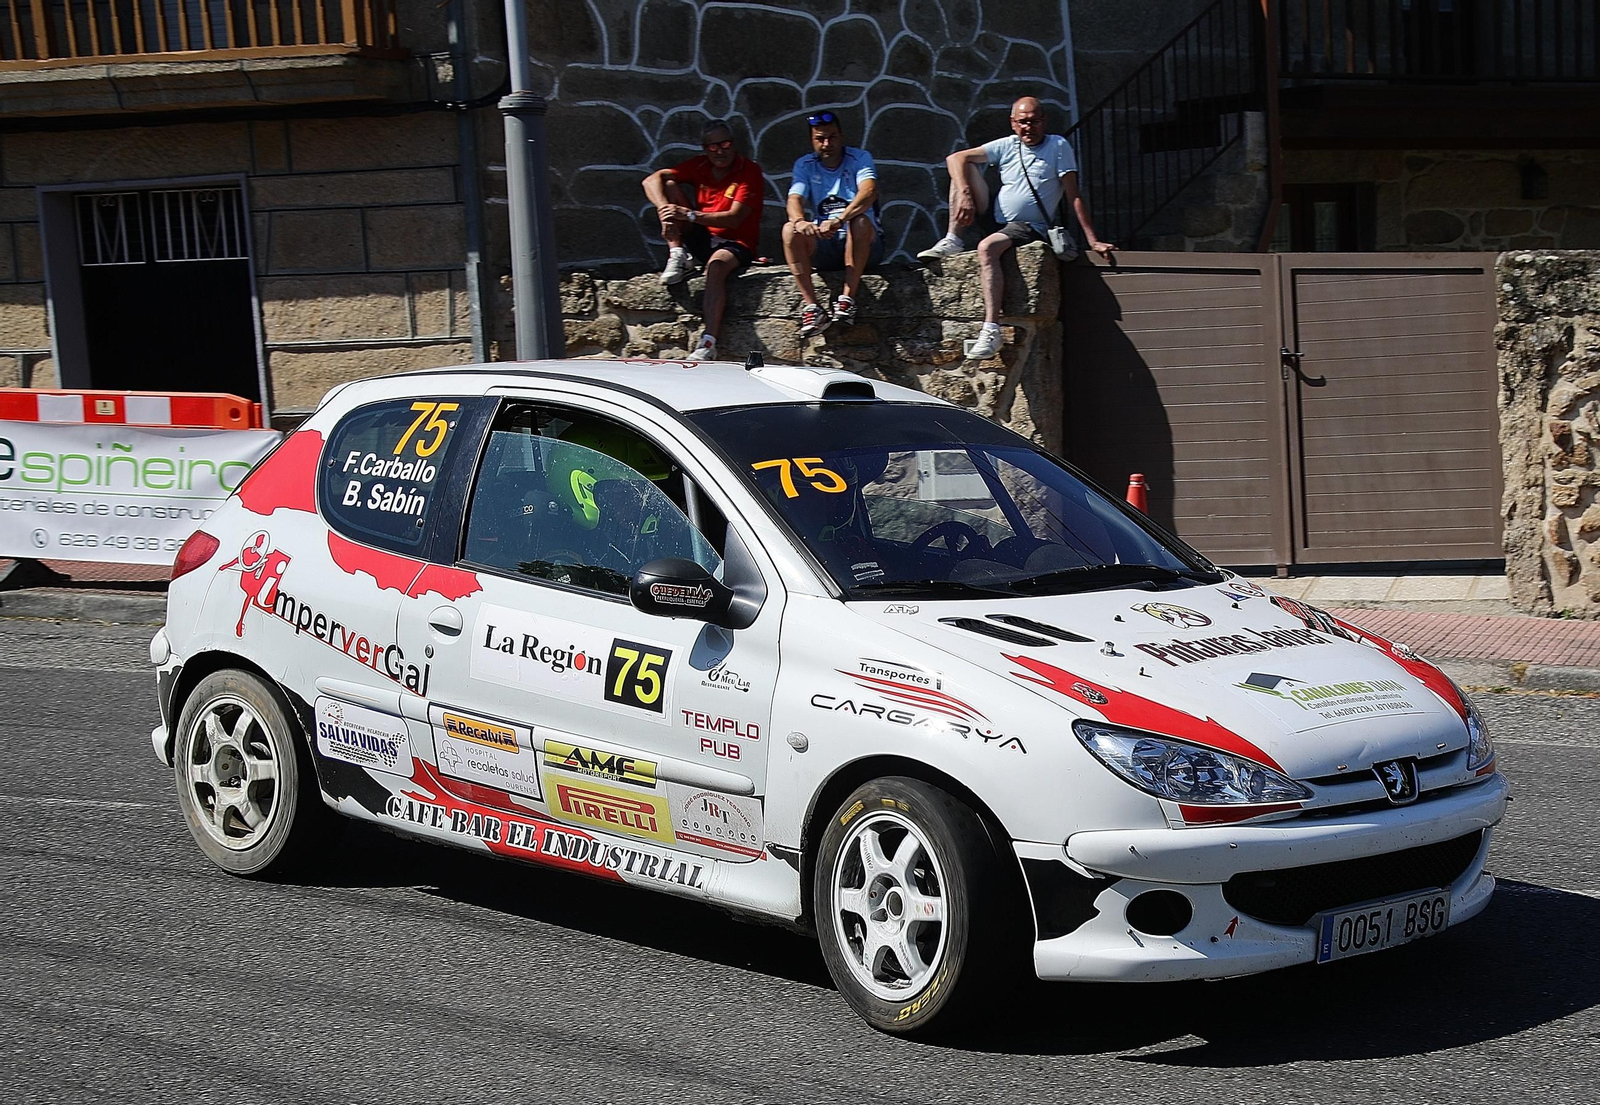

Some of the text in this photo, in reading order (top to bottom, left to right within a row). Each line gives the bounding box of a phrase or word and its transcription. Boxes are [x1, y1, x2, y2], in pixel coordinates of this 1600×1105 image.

[392, 401, 460, 458] 75
[342, 451, 437, 484] F.Carballo
[751, 457, 848, 499] 75
[83, 501, 110, 516] de
[342, 480, 425, 516] B. Sabín
[59, 533, 99, 547] 626
[102, 536, 129, 549] 49
[483, 624, 603, 676] La Región
[1133, 632, 1269, 667] Pinturas
[613, 647, 665, 704] 75
[859, 662, 931, 686] Transportes
[1290, 681, 1375, 702] CANALONES
[319, 721, 398, 757] SALVAVIDAS
[458, 721, 503, 745] Recalvi
[682, 710, 760, 740] TEMPLO
[464, 746, 498, 761] HOSPITAL
[700, 738, 741, 761] PUB
[467, 759, 536, 784] recoletas salud
[577, 767, 622, 782] MOTORSPORT
[505, 781, 538, 796] OURENSE
[556, 784, 658, 833] PIRELLI
[701, 798, 731, 824] JRT
[386, 796, 444, 830] CAFE
[451, 811, 501, 842] BAR
[508, 823, 538, 851] EL
[543, 832, 704, 891] INDUSTRIAL
[1338, 897, 1445, 952] 0051 BSG
